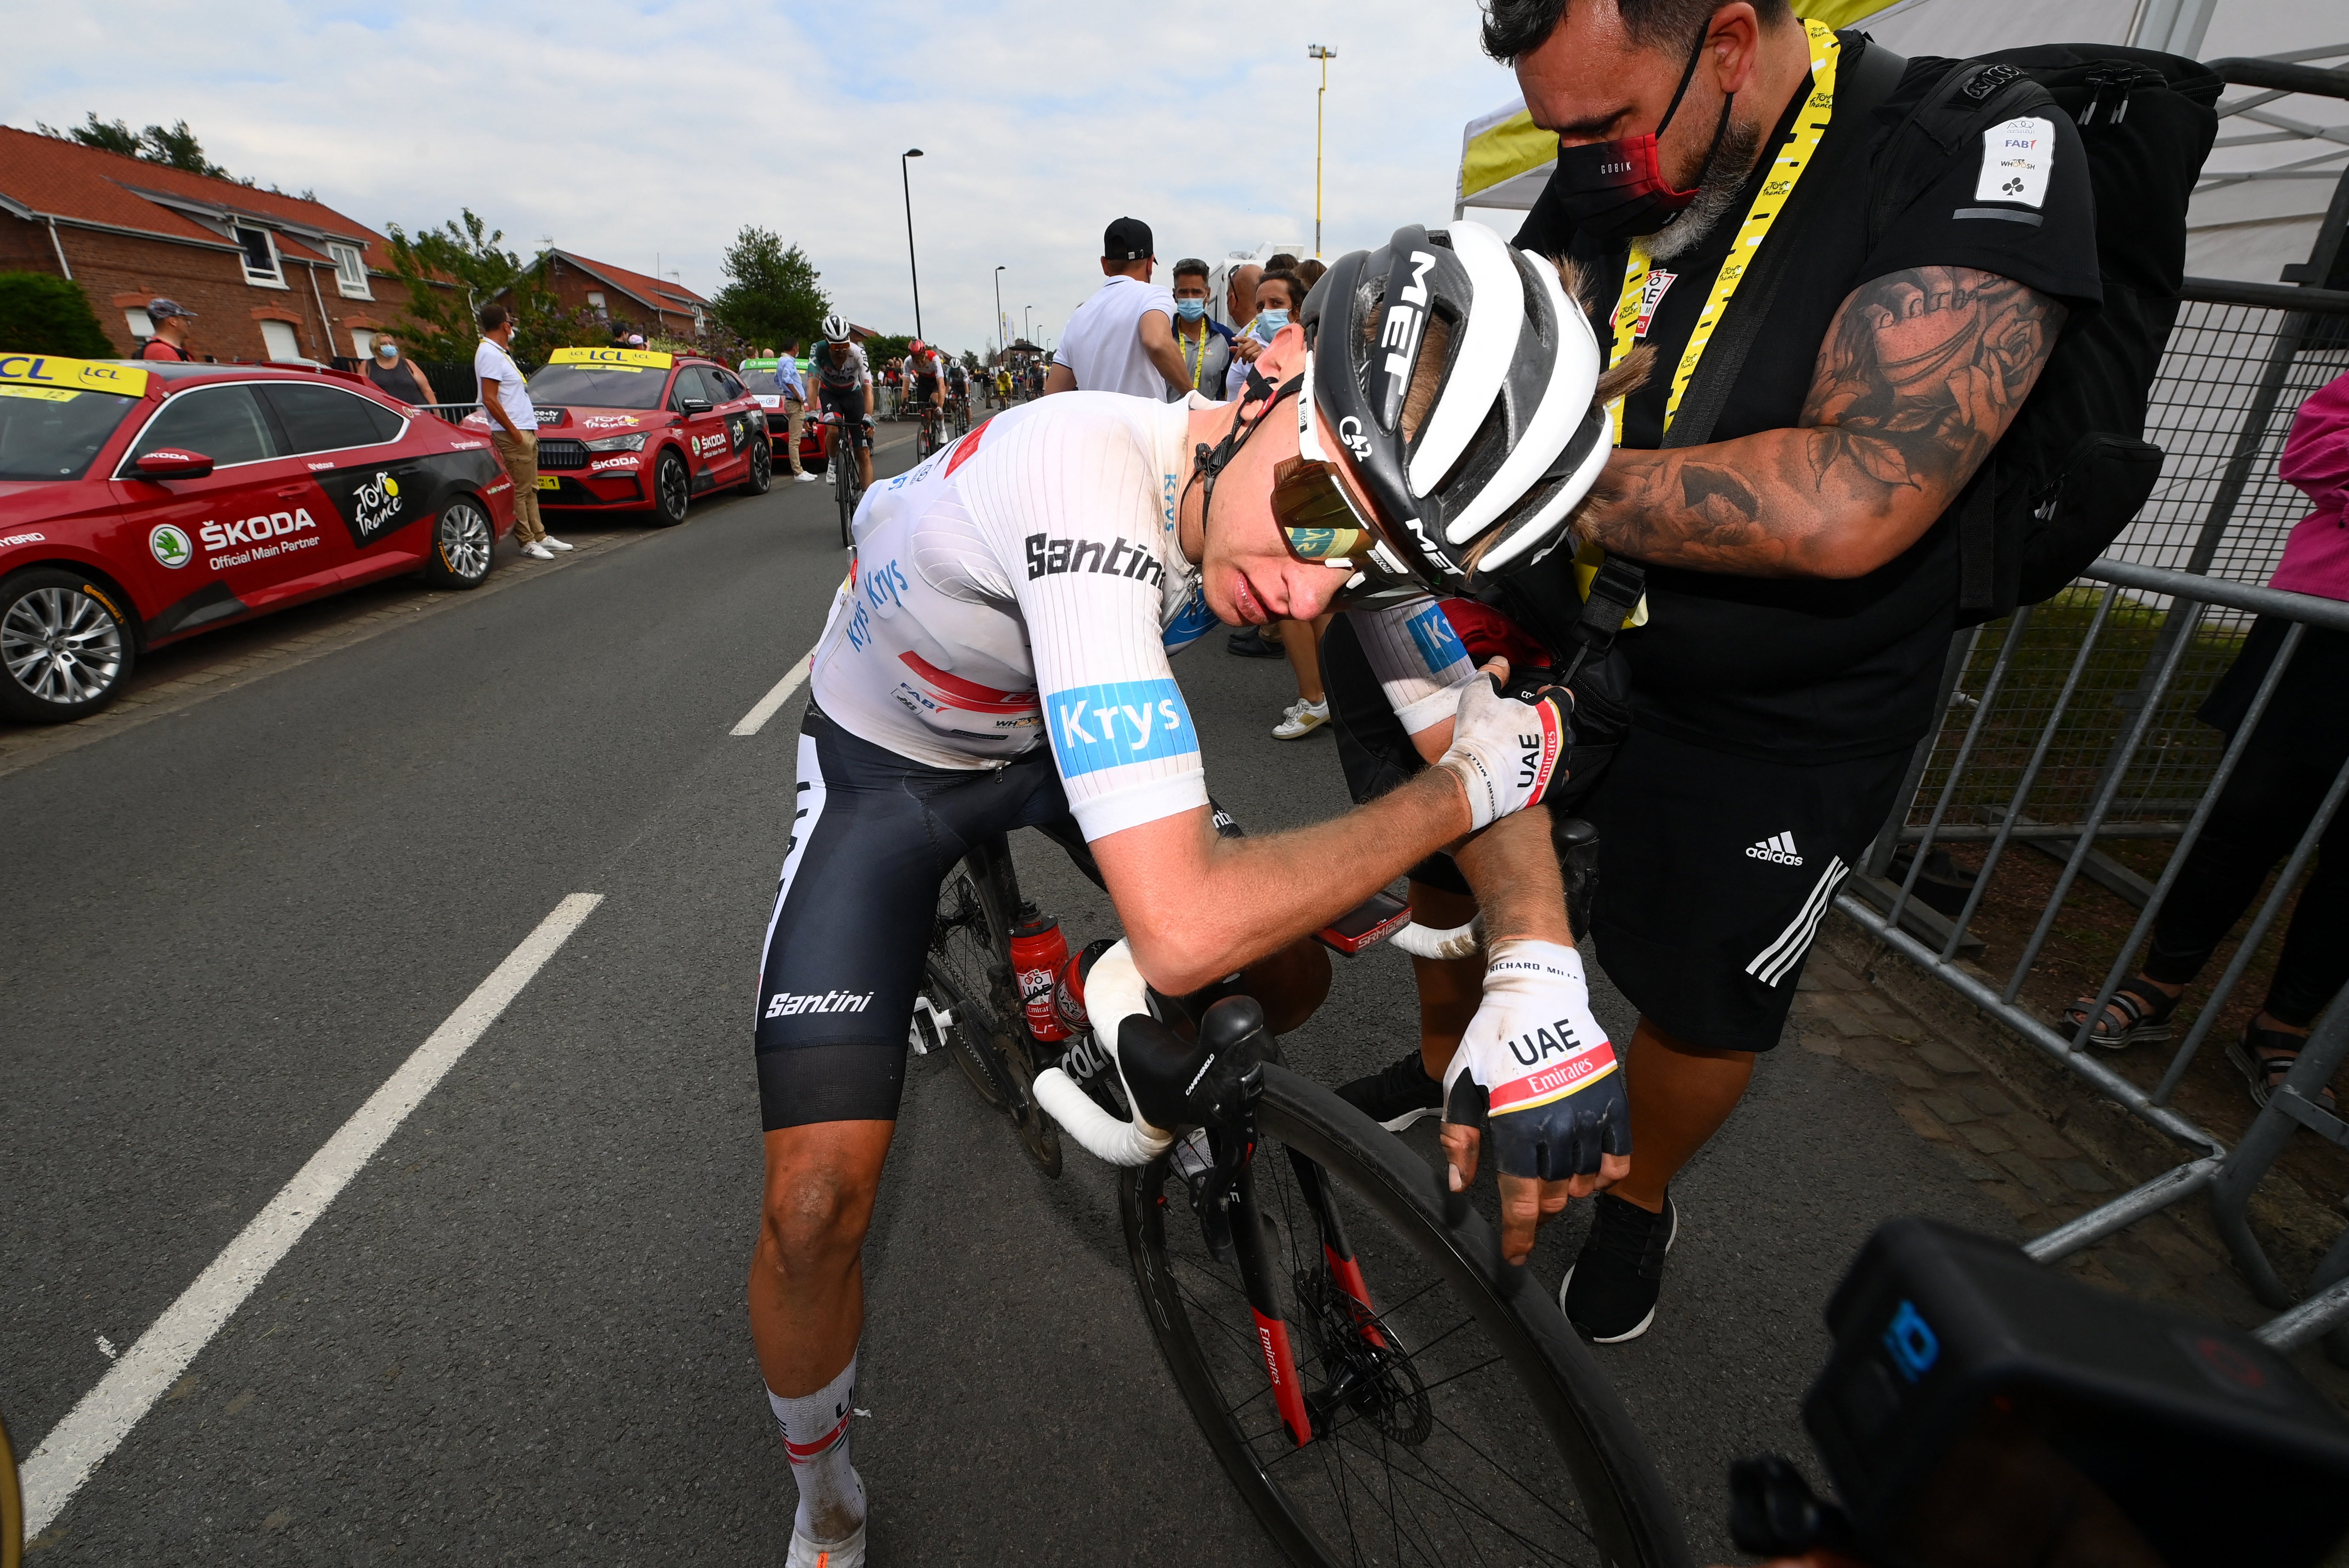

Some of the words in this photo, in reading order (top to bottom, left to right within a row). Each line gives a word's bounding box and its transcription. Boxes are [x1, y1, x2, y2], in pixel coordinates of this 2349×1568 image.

[2005, 139, 2029, 149] FAB
[1601, 161, 1631, 174] GOBIK
[1641, 287, 1661, 304] AE
[1381, 251, 1436, 396] MET
[0, 357, 54, 380] CL
[84, 367, 120, 380] LCL
[589, 350, 628, 362] LCL
[701, 433, 727, 450] ŠKODA
[591, 456, 640, 471] ŠKODA
[548, 478, 556, 487] 1
[1164, 474, 1177, 532] Krys
[0, 532, 46, 547] YBRID
[199, 508, 317, 552] ŠKODA
[1405, 518, 1465, 576] MET
[209, 550, 251, 571] Official
[251, 545, 280, 561] Main
[280, 536, 320, 553] Partner
[1025, 532, 1166, 591] Santin
[864, 559, 908, 610] Krys
[846, 600, 872, 654] Krys
[900, 682, 936, 709] FAB
[1060, 699, 1181, 751] Krys
[1516, 734, 1540, 788] UAE
[1537, 731, 1556, 786] Emirates
[1745, 847, 1803, 866] adidas
[1358, 927, 1385, 949] SRM
[765, 990, 875, 1019] Santini
[1508, 1018, 1581, 1066] UAE
[1185, 1053, 1215, 1096] CAMPAGNOLO
[1526, 1057, 1593, 1094] Emirates
[1258, 1328, 1282, 1386] Emirates
